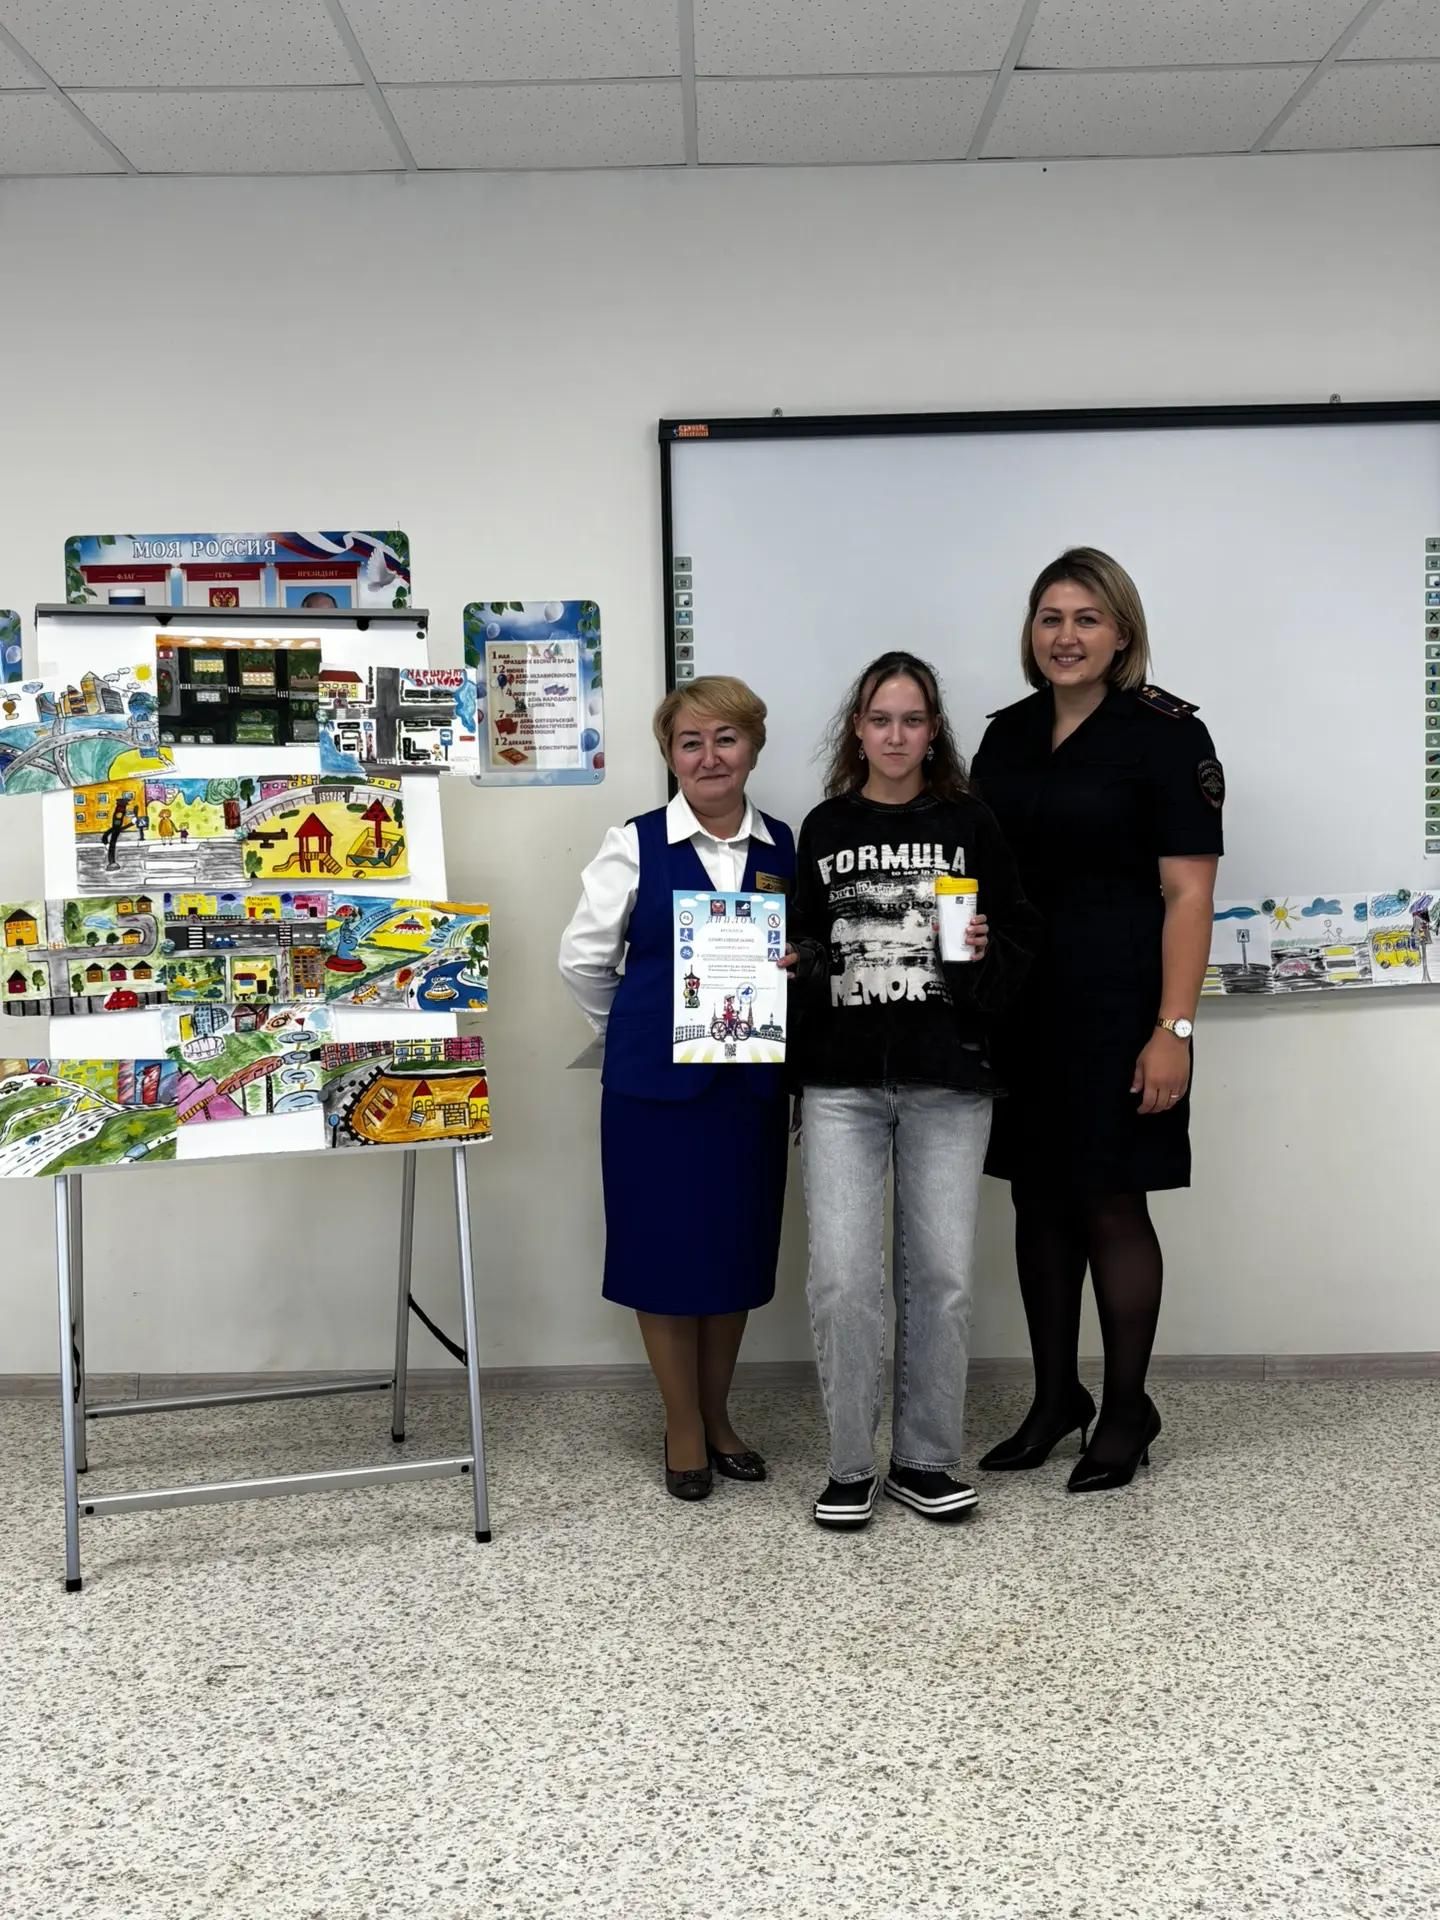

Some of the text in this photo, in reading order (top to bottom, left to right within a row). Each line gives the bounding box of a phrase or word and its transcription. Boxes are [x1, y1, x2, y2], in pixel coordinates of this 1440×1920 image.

[132, 539, 277, 558] МОЯ РОССИЯ
[297, 570, 338, 578] ПРЕЗИДЕНТ
[492, 651, 497, 659] 1
[492, 665, 505, 674] 12
[498, 710, 504, 718] 7
[495, 737, 507, 745] 12
[817, 843, 966, 885] FORMULA
